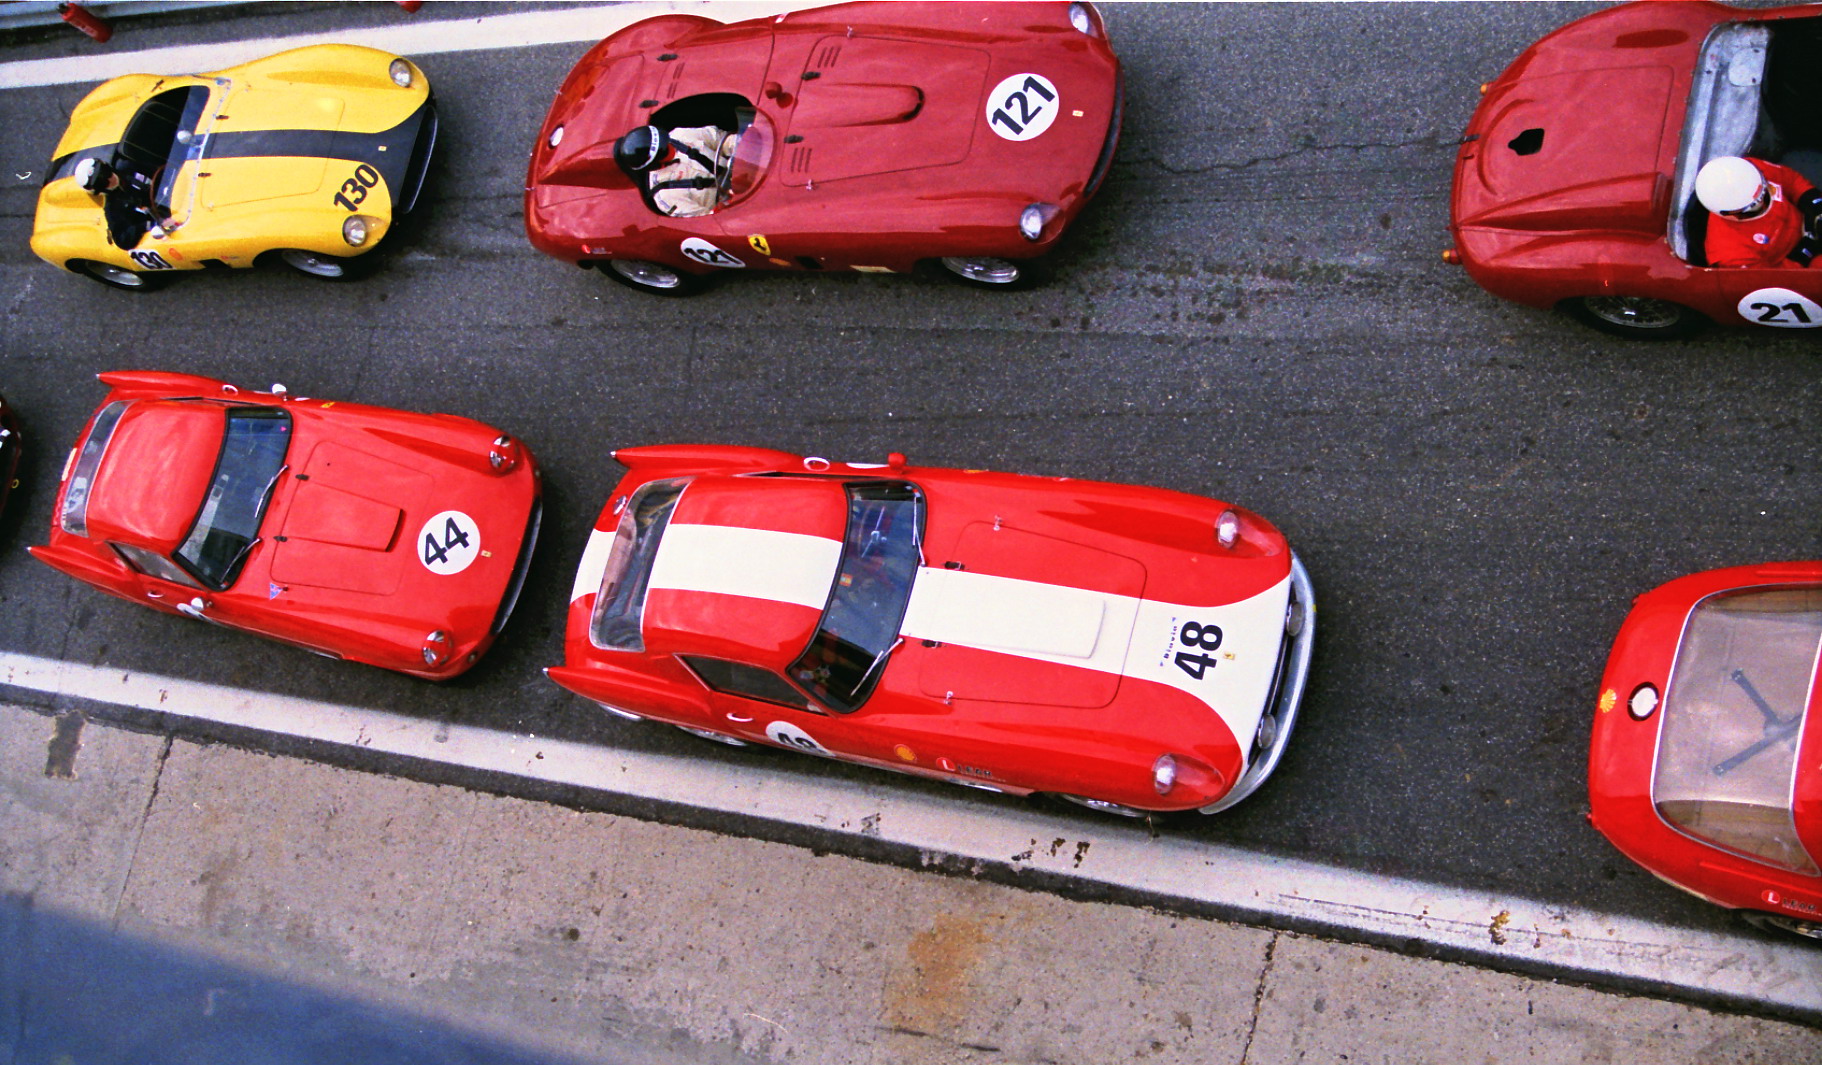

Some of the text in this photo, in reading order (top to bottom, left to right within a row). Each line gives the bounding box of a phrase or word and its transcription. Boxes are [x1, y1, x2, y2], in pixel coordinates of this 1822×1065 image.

[991, 76, 1055, 135] 121
[334, 164, 379, 212] 130
[130, 251, 173, 269] 130
[684, 247, 743, 264] 121
[1750, 302, 1812, 323] 21
[425, 517, 469, 565] 44
[1174, 621, 1223, 680] 48
